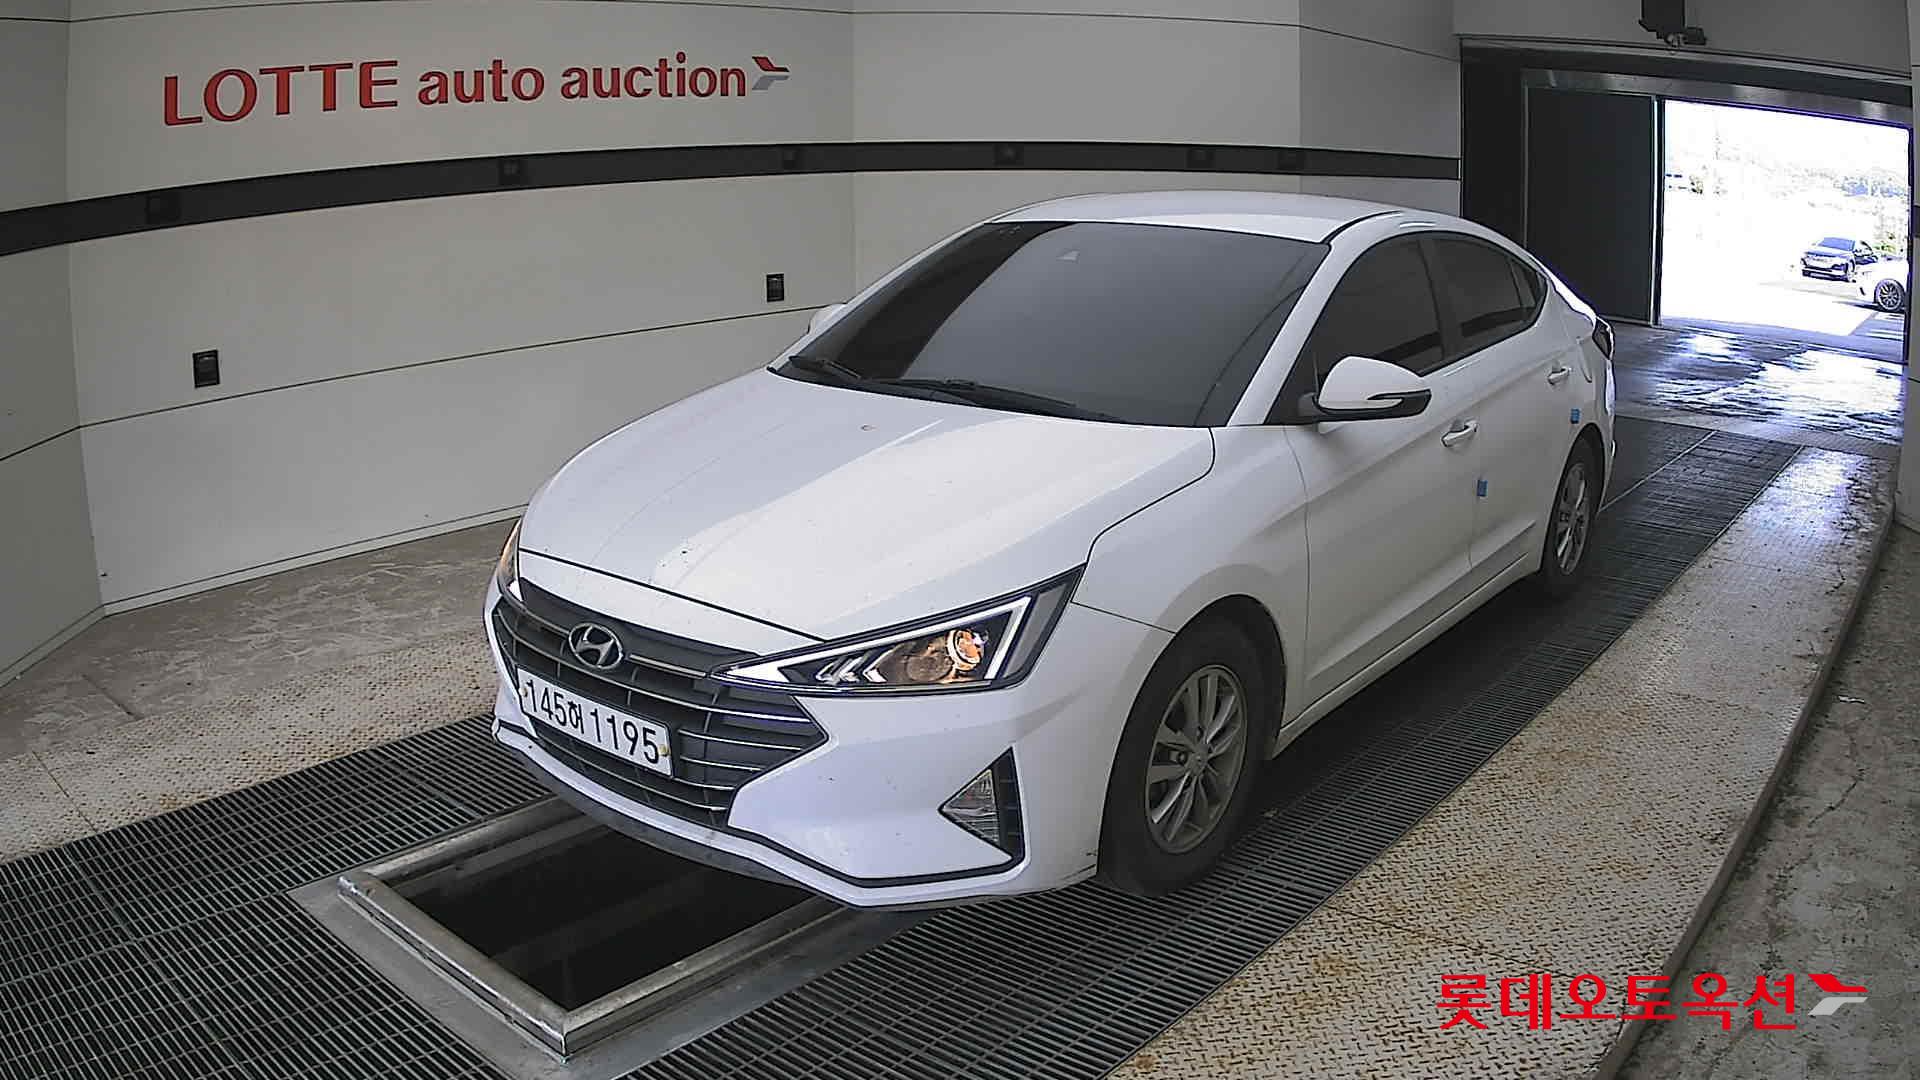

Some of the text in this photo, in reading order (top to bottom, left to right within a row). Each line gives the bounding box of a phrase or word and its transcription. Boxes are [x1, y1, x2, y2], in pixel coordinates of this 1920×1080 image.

[163, 52, 746, 126] LOTTE auto auction
